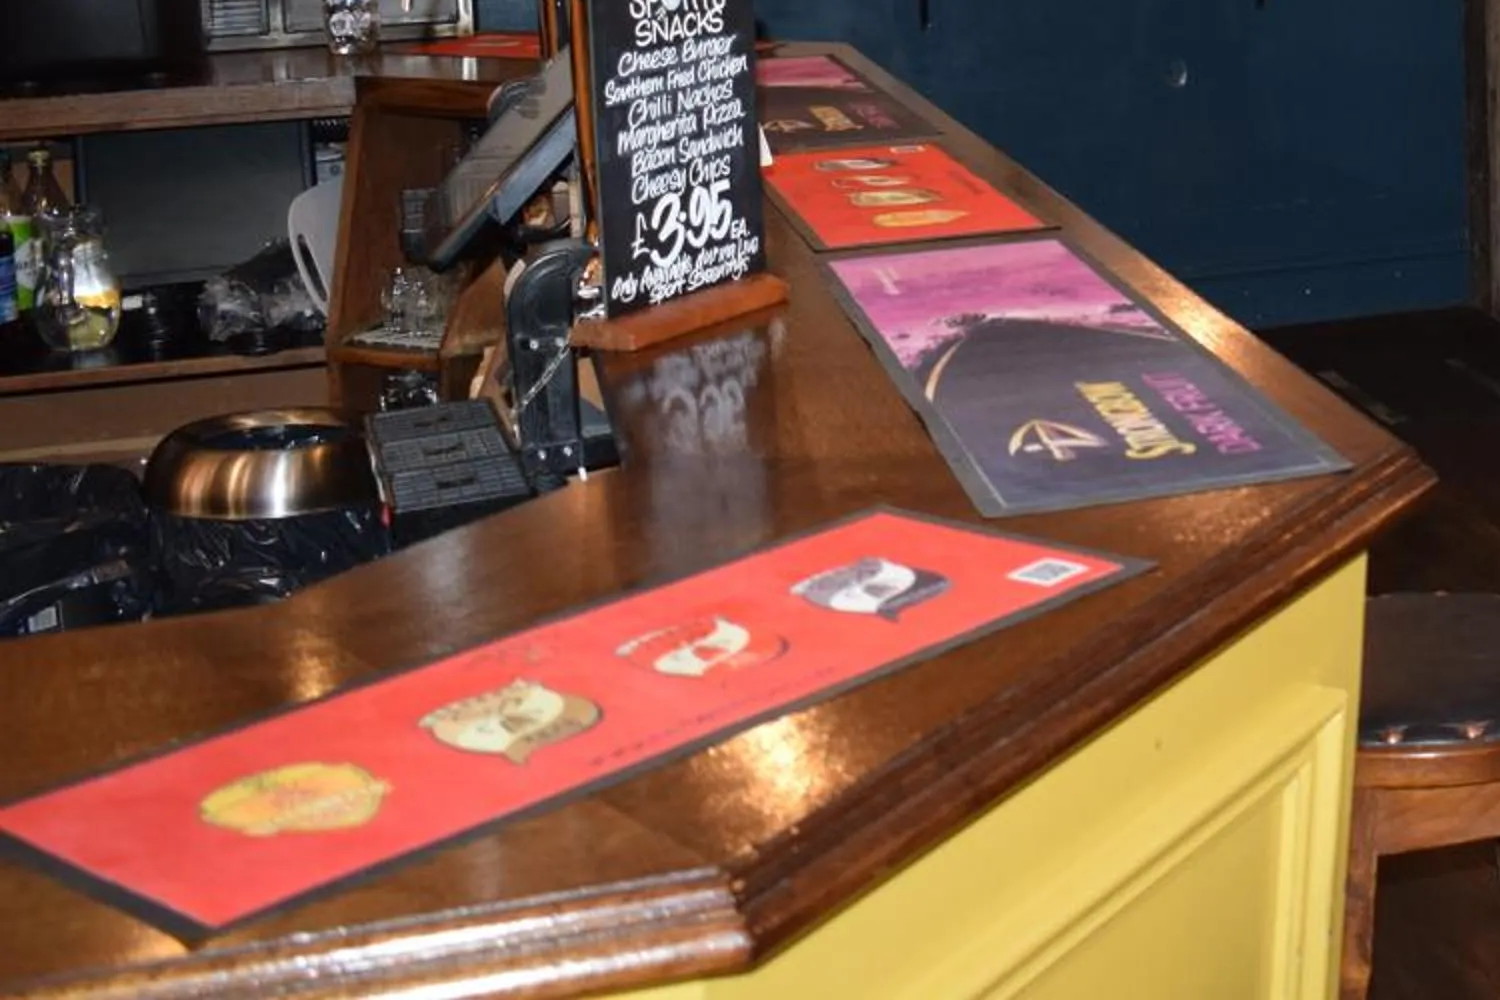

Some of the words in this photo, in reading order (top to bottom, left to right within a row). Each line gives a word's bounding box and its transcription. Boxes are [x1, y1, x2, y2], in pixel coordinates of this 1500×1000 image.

[635, 8, 724, 46] SNACKS
[605, 77, 664, 107] Southern
[667, 65, 696, 90] Fried
[697, 54, 748, 83] Chicken
[618, 47, 679, 77] Cheese
[681, 35, 737, 64] Burger
[617, 114, 698, 155] Margherita
[703, 98, 747, 131] Pizza
[628, 96, 672, 128] Chilli
[677, 79, 733, 112] Nachos
[632, 147, 676, 178] Bacon
[679, 124, 744, 163] Sandwich
[631, 168, 687, 205] Cheesy
[689, 154, 732, 187] Chips
